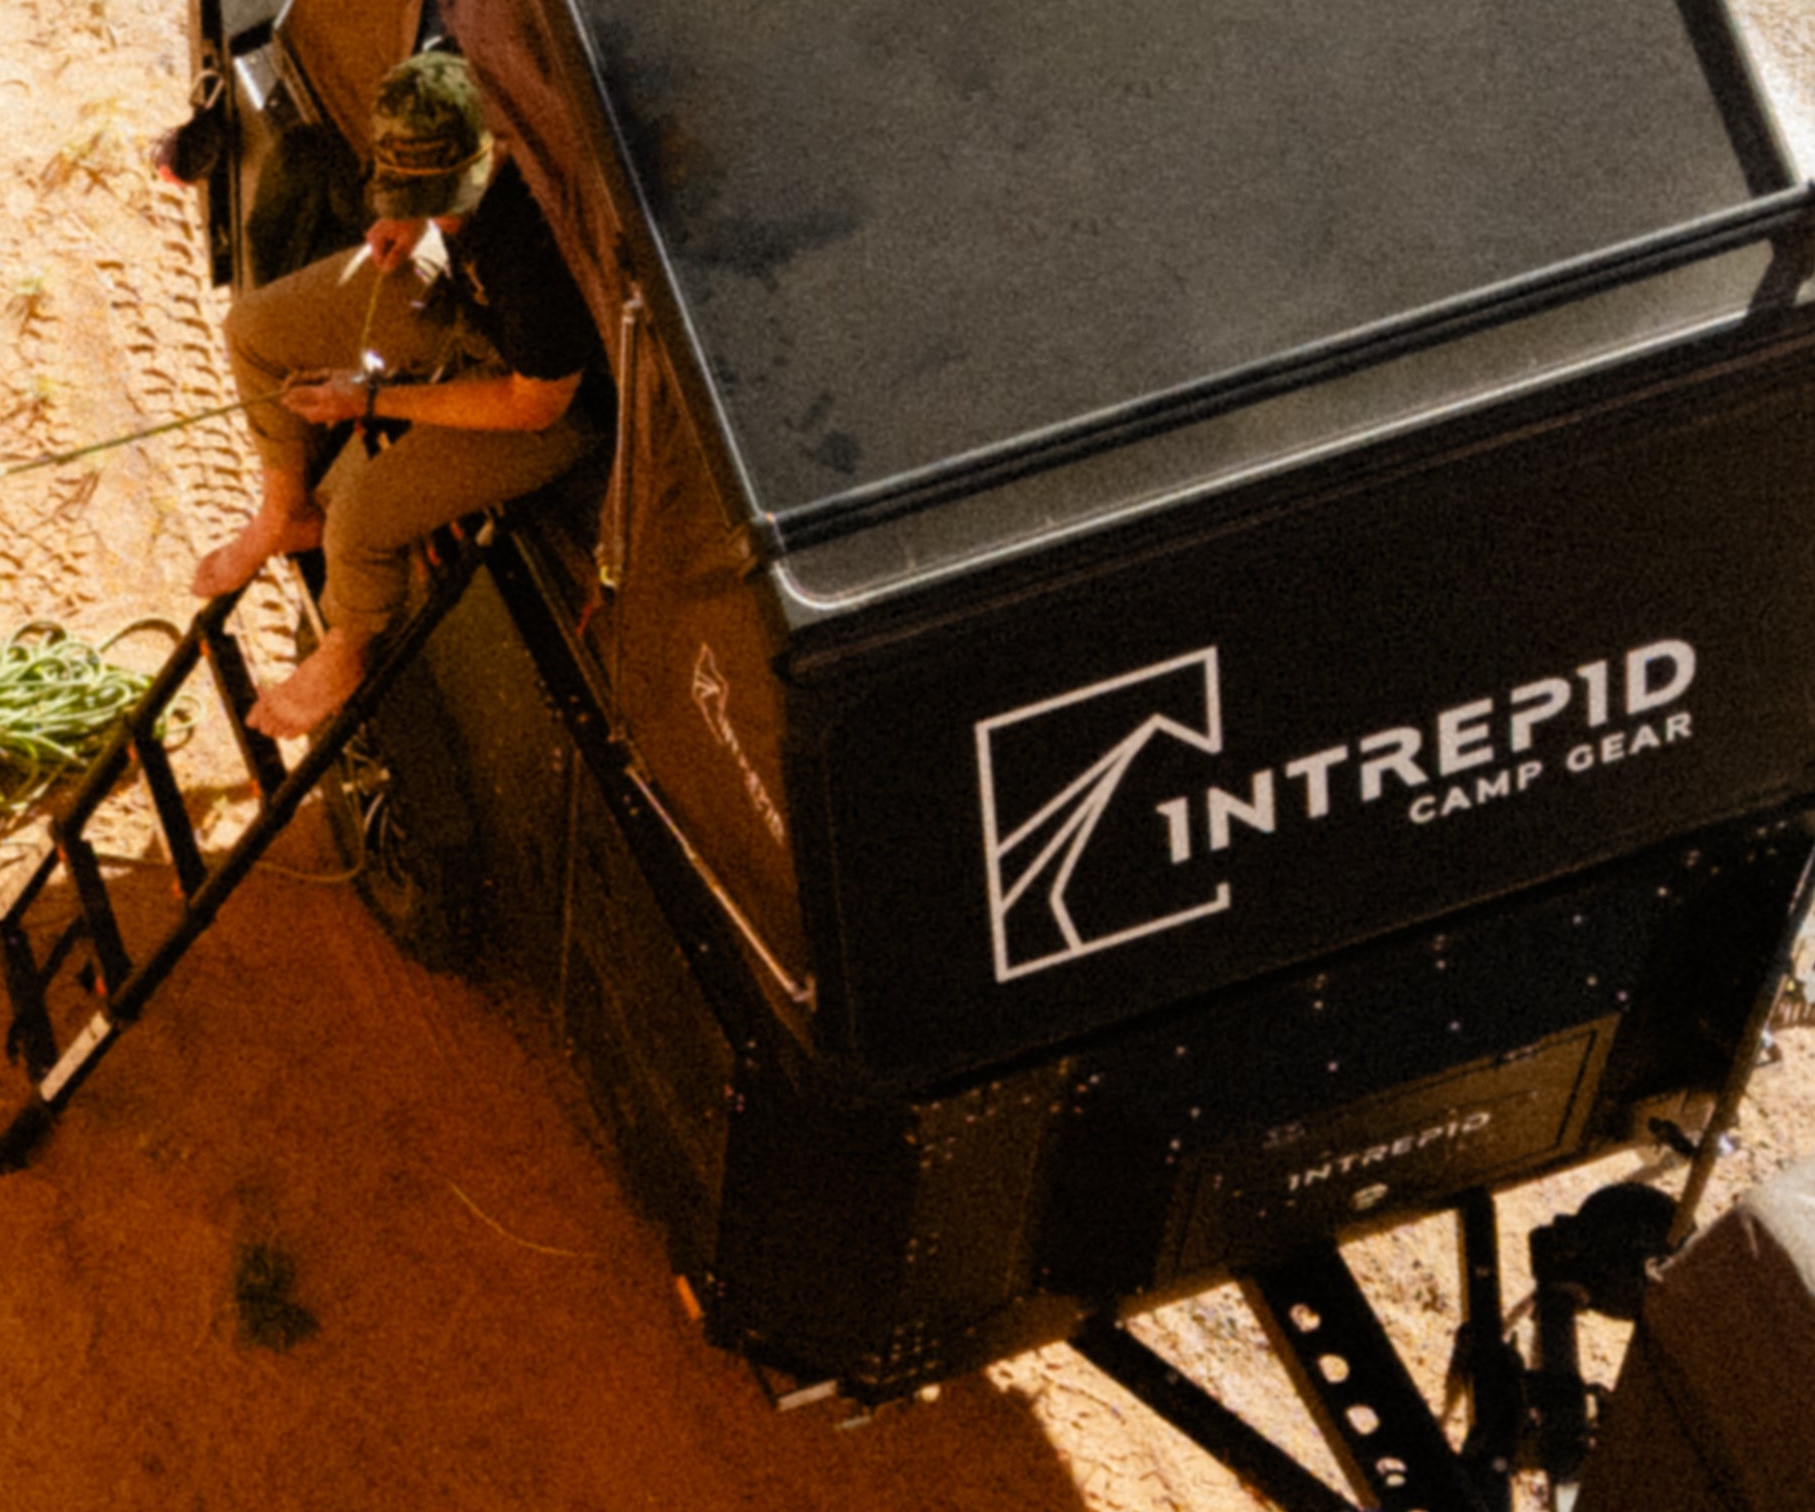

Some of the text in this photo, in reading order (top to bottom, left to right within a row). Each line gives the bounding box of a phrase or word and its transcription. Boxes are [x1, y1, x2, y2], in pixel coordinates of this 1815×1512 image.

[1156, 639, 1697, 864] INTREPID
[1408, 711, 1694, 825] CAMP GEAR
[1289, 1111, 1492, 1191] INTREPID
